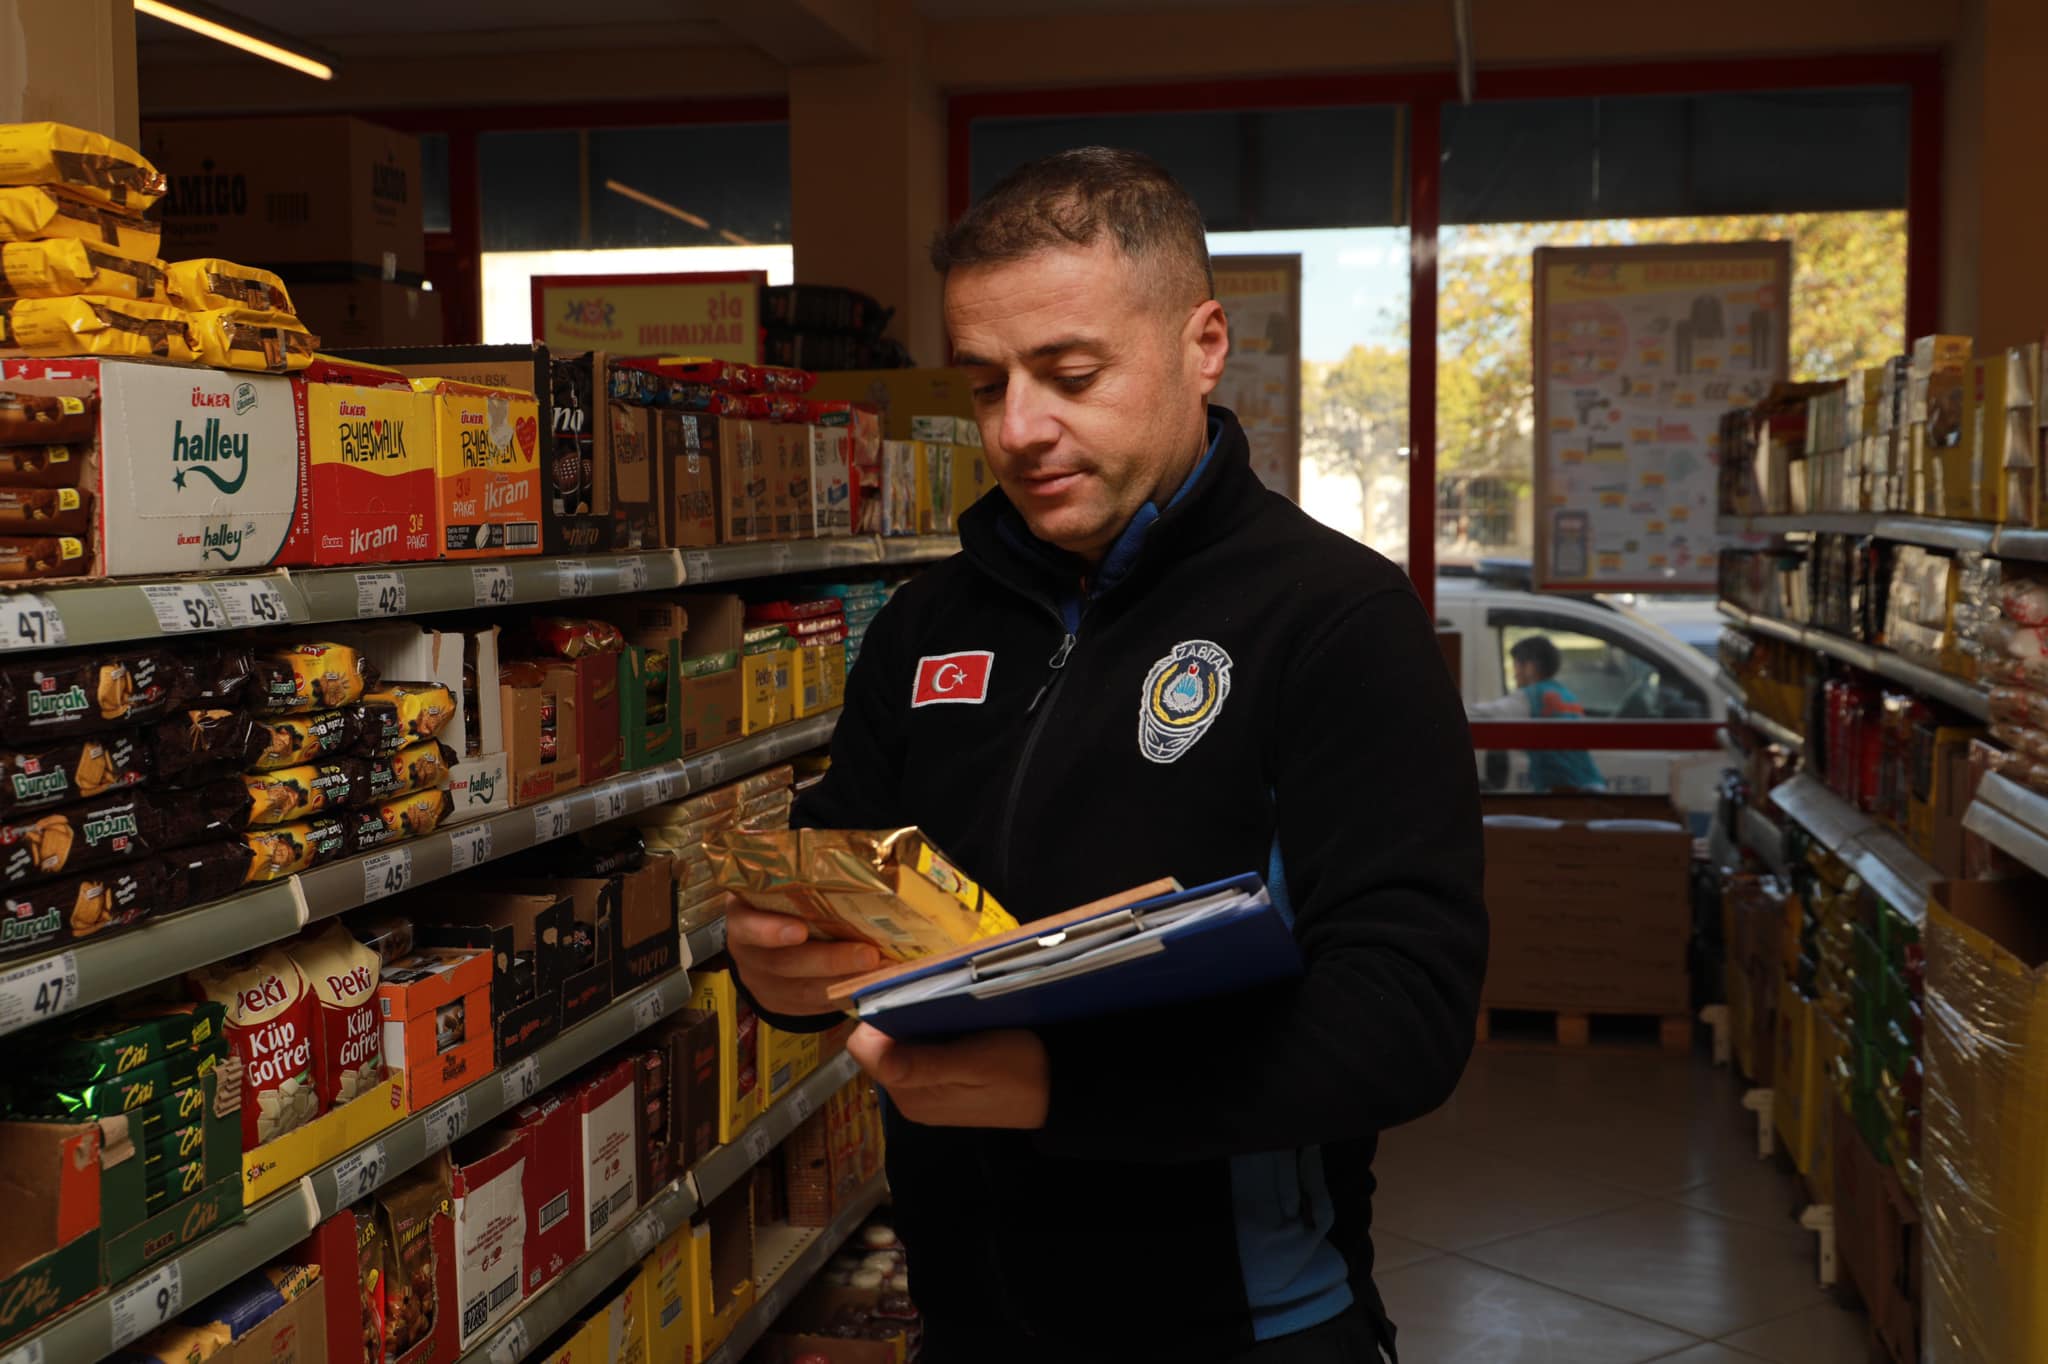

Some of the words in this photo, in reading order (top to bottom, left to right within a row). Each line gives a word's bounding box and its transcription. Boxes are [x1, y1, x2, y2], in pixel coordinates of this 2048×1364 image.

[192, 387, 230, 408] ÜLKER
[340, 401, 366, 417] ÜLKER
[461, 411, 483, 425] ÜLKER
[173, 418, 249, 494] halley
[483, 479, 530, 512] ikram
[203, 525, 243, 561] halley
[349, 523, 398, 556] ikram
[379, 586, 397, 613] 42
[489, 579, 505, 603] 42
[574, 575, 587, 598] 59
[183, 599, 214, 629] 52
[251, 593, 277, 621] 45
[19, 612, 45, 643] 47
[1177, 645, 1225, 671] ZABITA
[27, 685, 90, 716] Burçak
[11, 763, 68, 803] Burçak
[469, 772, 495, 804] halley
[656, 779, 667, 798] 14
[608, 796, 621, 816] 14
[83, 812, 139, 848] Burçak
[552, 816, 565, 836] 21
[471, 840, 485, 864] 18
[384, 864, 403, 893] 45
[1, 906, 62, 942] Burçak
[35, 978, 63, 1015] 47
[347, 1007, 373, 1039] Küp
[249, 1021, 295, 1059] Küp
[248, 1037, 311, 1088] Gofret
[521, 1071, 533, 1098] 16
[447, 1112, 459, 1140] 31
[359, 1160, 377, 1194] 29
[158, 1288, 169, 1321] 9
